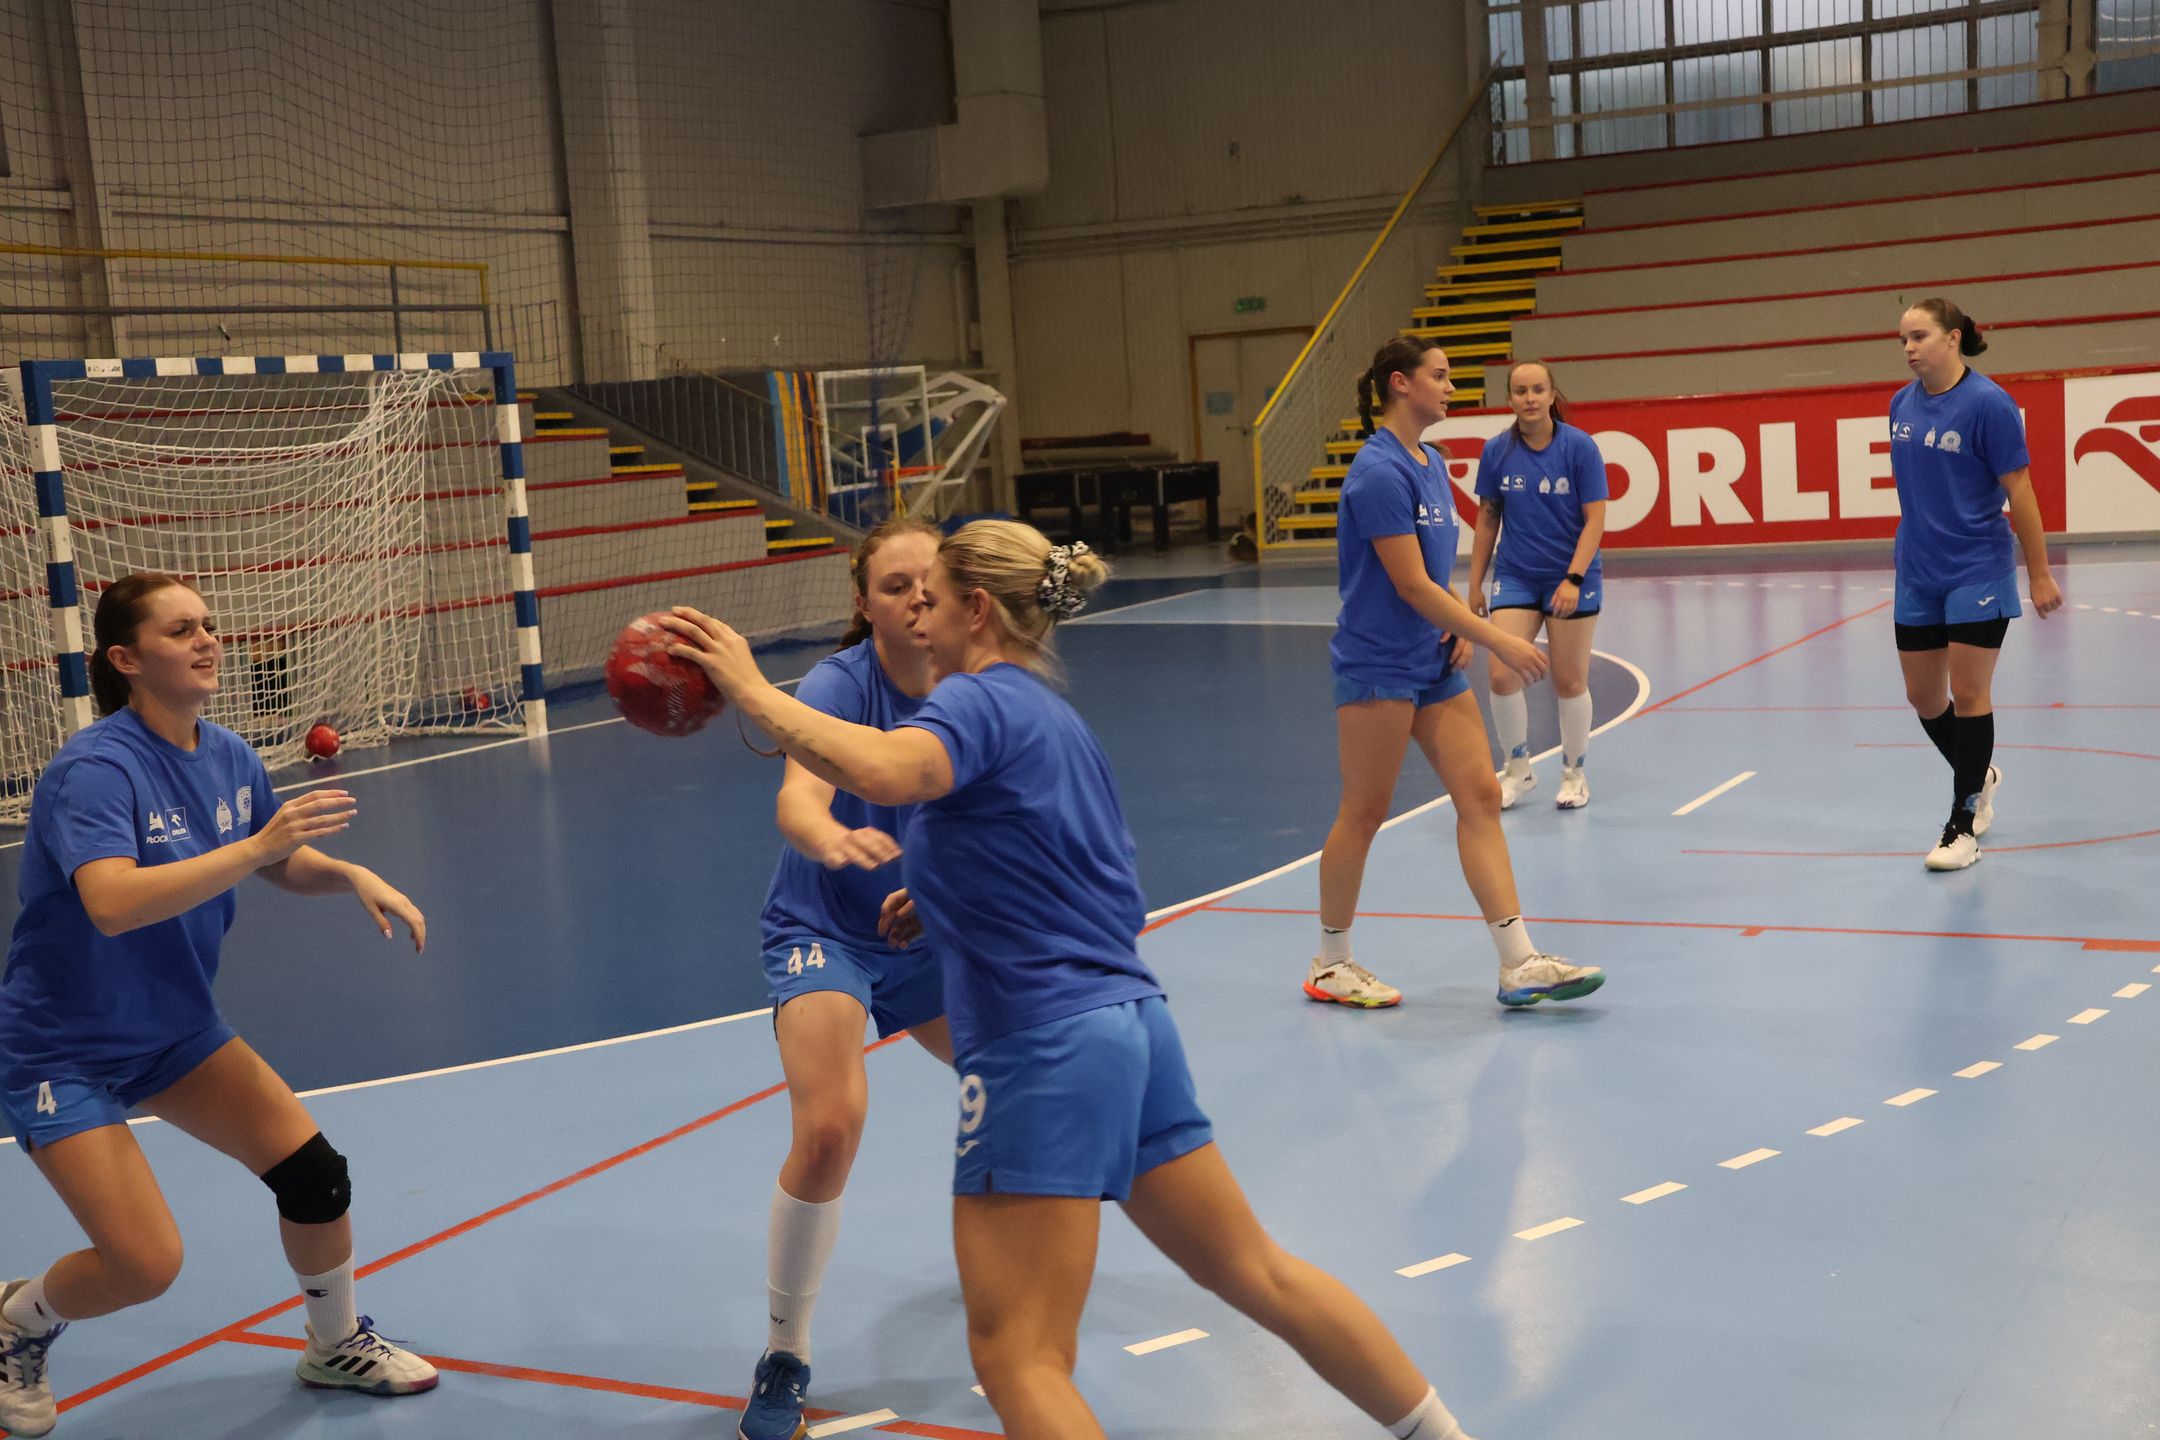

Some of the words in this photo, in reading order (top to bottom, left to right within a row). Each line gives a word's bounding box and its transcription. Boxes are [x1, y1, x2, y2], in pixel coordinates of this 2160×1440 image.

[1592, 408, 2025, 532] ORLE
[787, 942, 826, 976] 44
[37, 1080, 57, 1115] 4
[960, 1074, 987, 1133] 9
